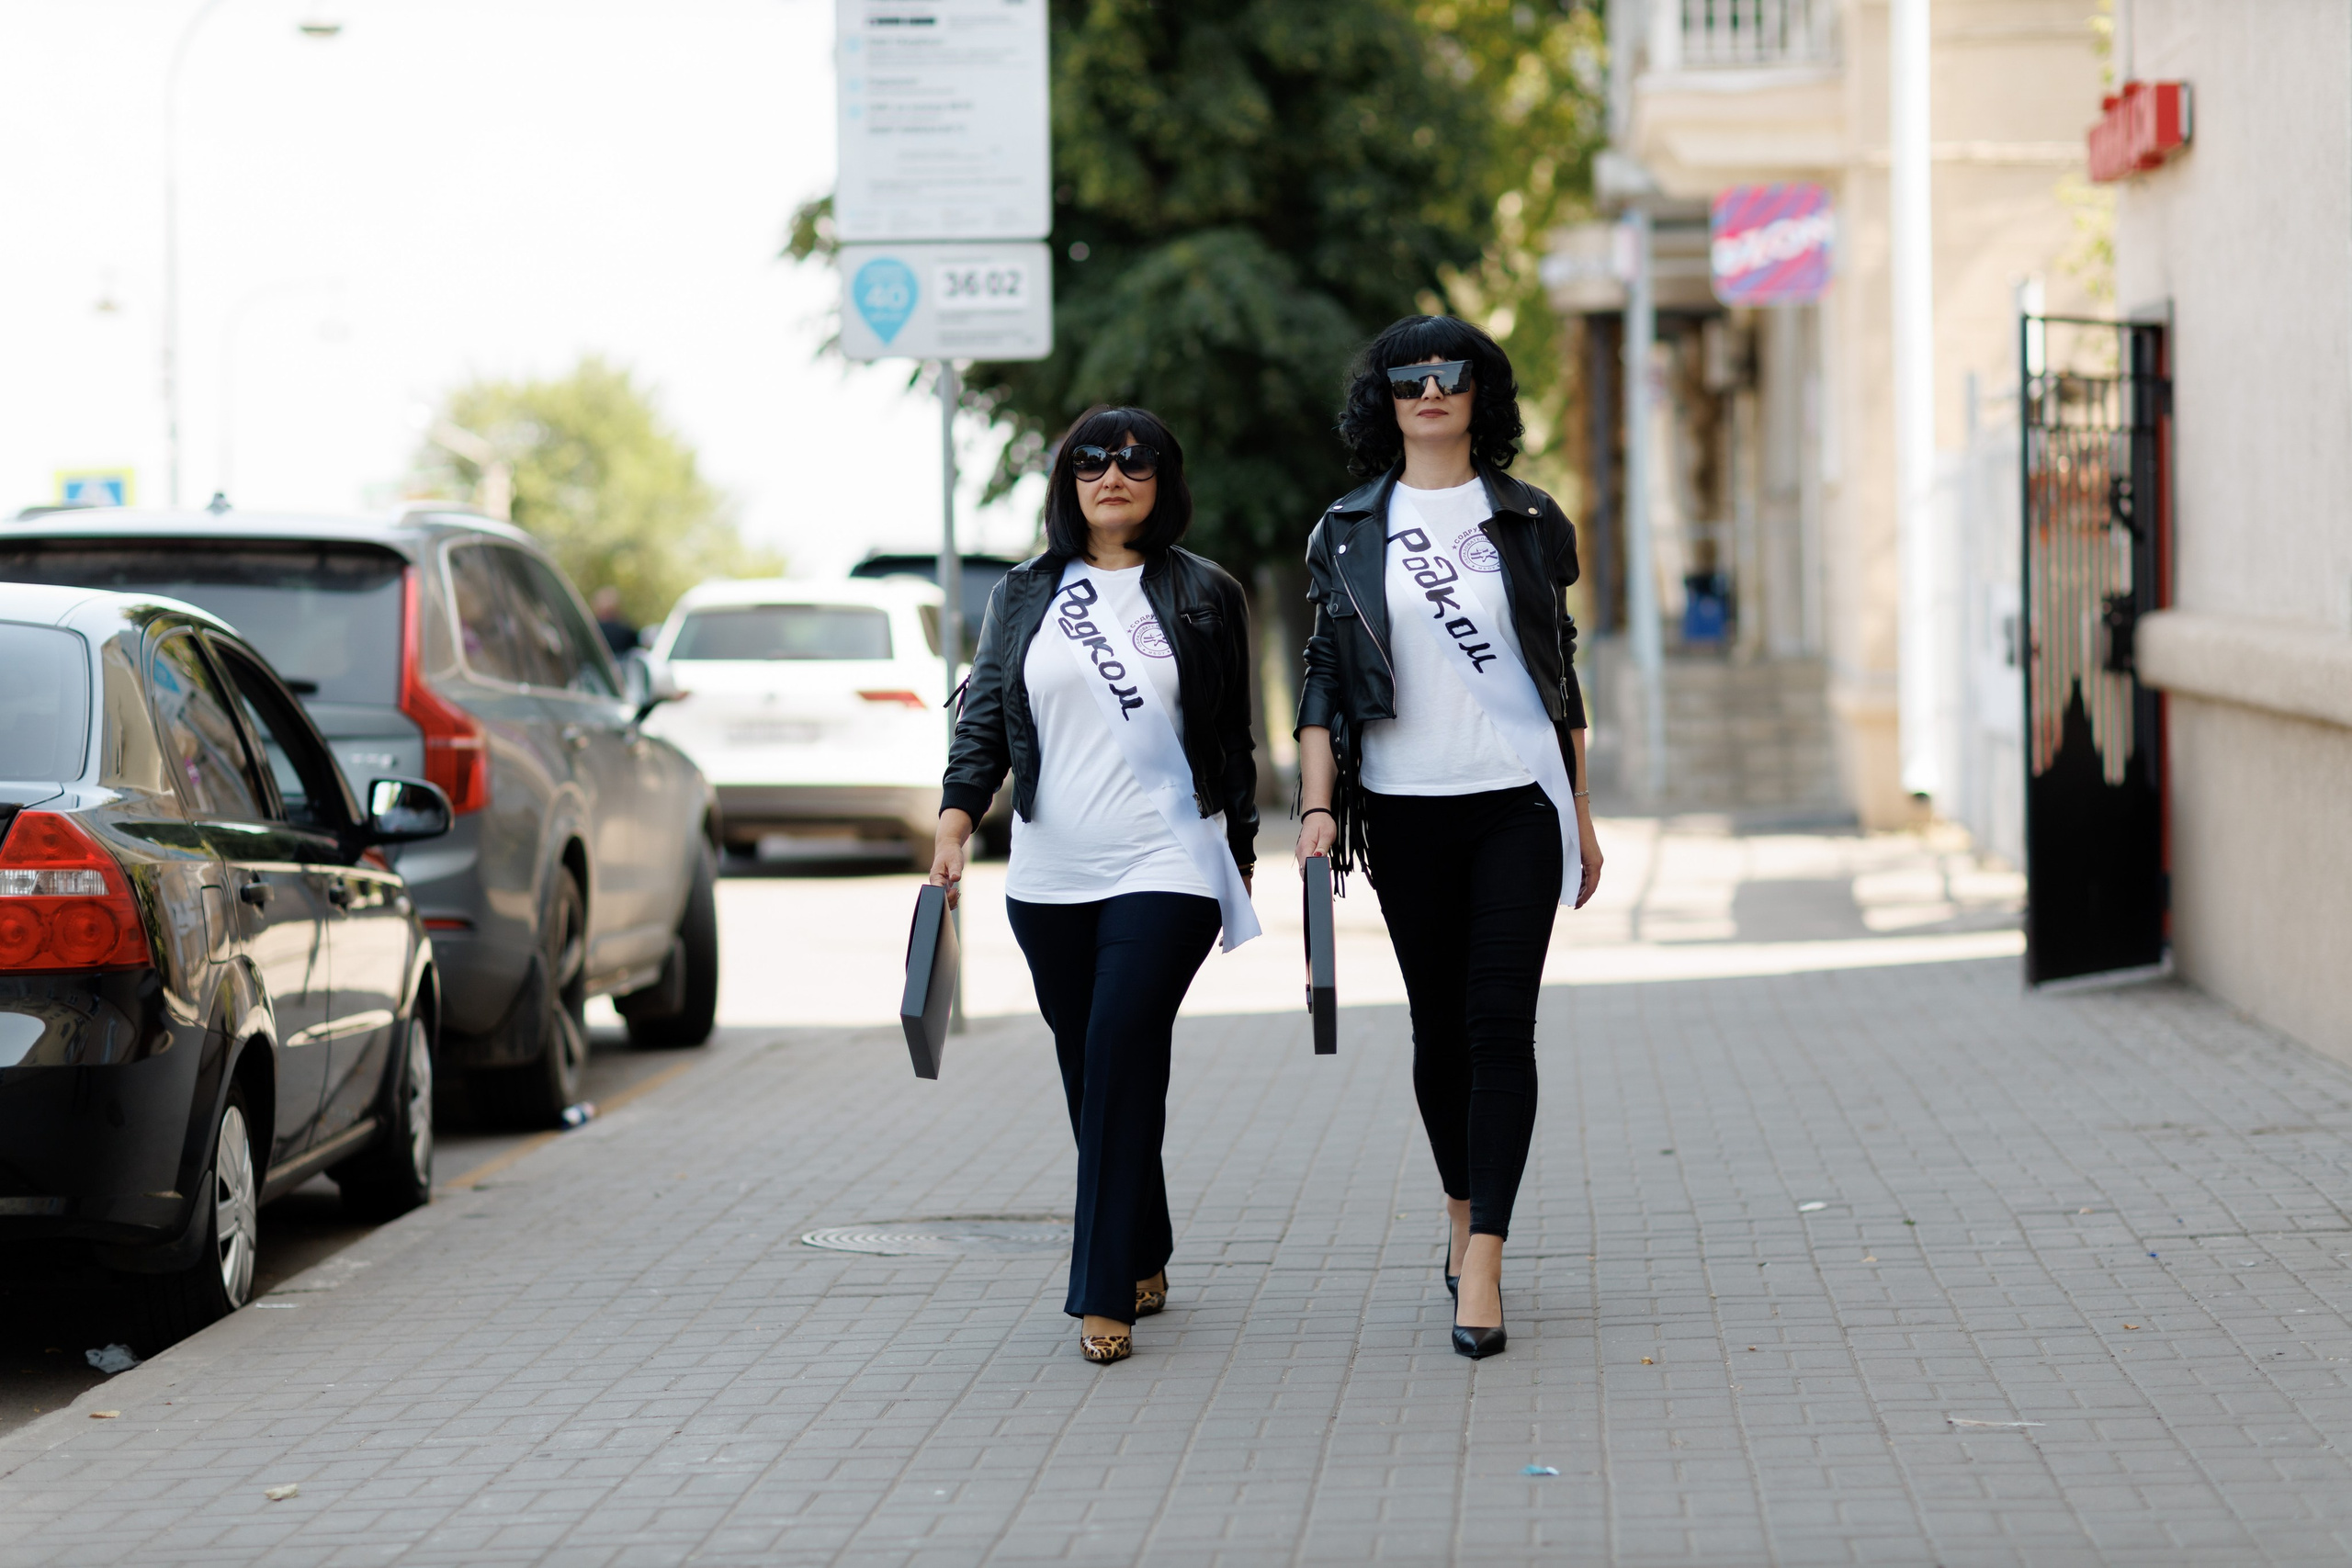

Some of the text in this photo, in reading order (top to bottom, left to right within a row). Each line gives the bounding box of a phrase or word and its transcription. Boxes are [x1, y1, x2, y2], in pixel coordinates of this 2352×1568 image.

[1453, 526, 1481, 544] СОДРУ
[1129, 614, 1158, 628] СОДРУ
[1387, 527, 1498, 673] Родком
[1056, 578, 1145, 721] Родком
